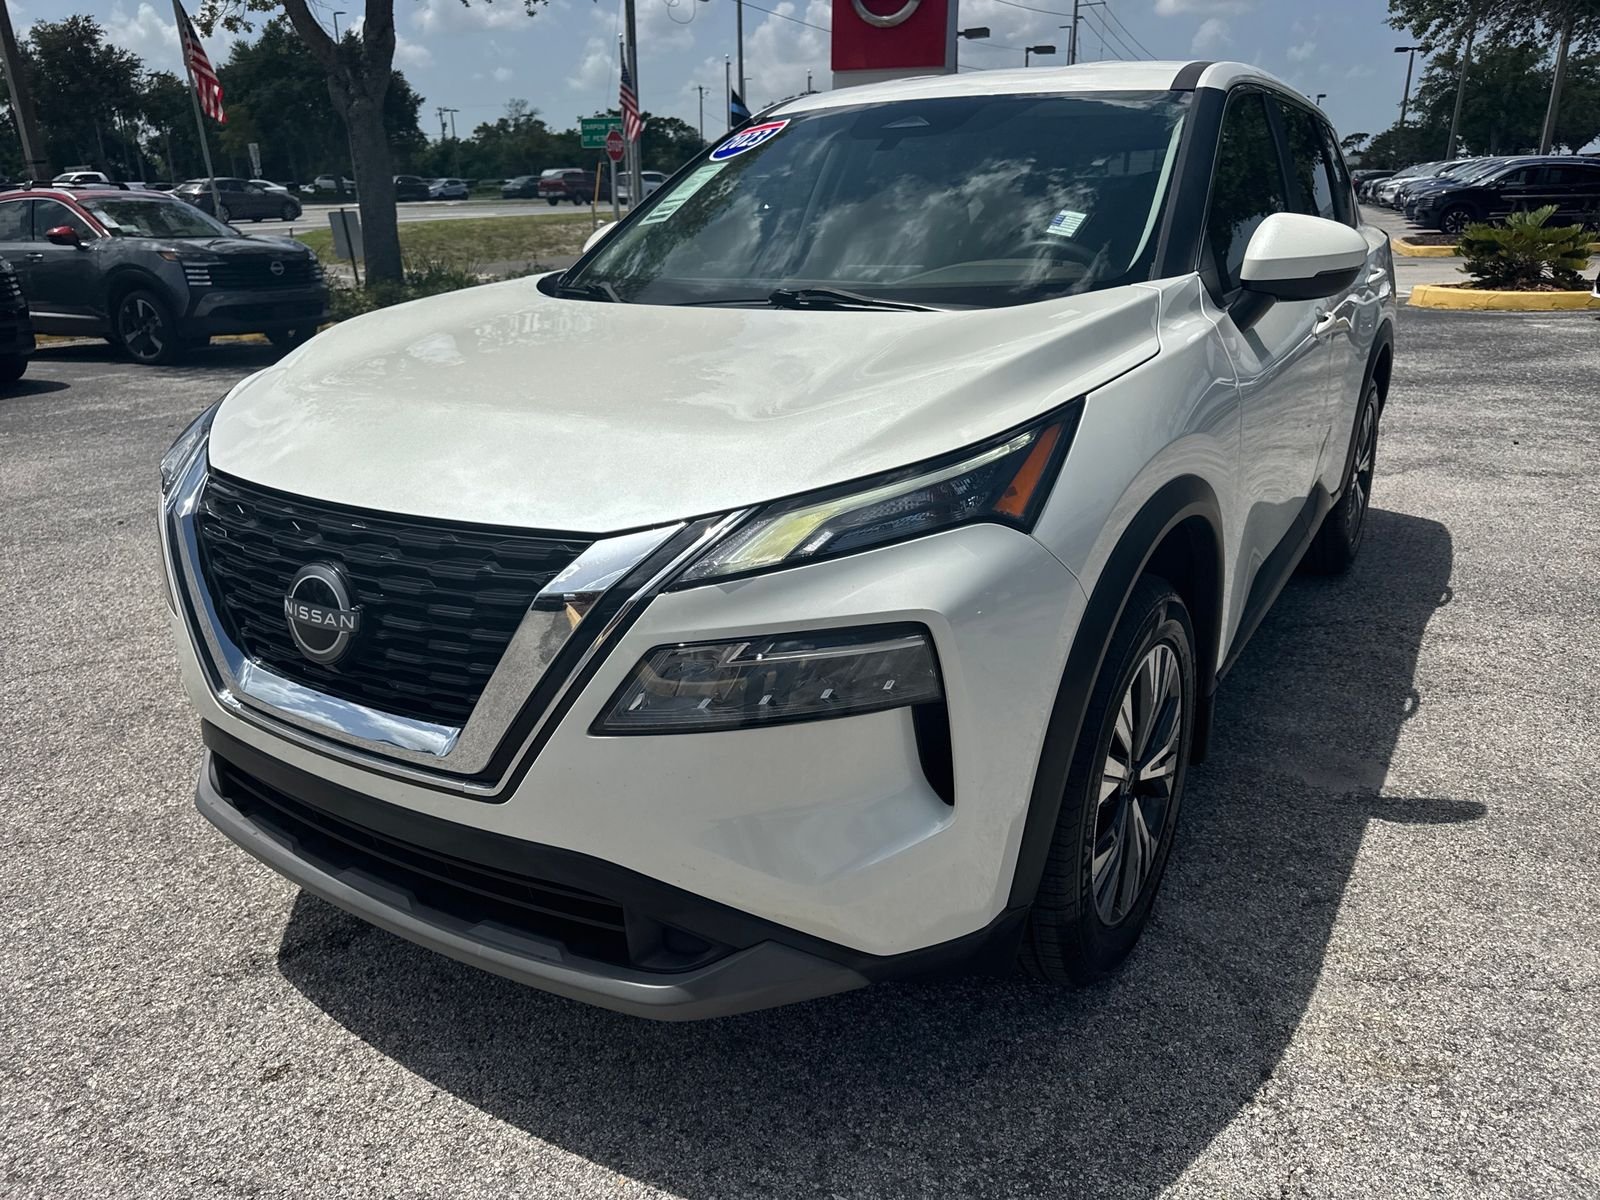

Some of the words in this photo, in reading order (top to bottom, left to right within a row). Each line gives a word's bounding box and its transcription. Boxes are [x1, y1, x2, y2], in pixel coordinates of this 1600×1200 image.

[607, 140, 624, 152] STOP
[717, 129, 773, 152] 2023
[284, 599, 355, 629] NISSAN
